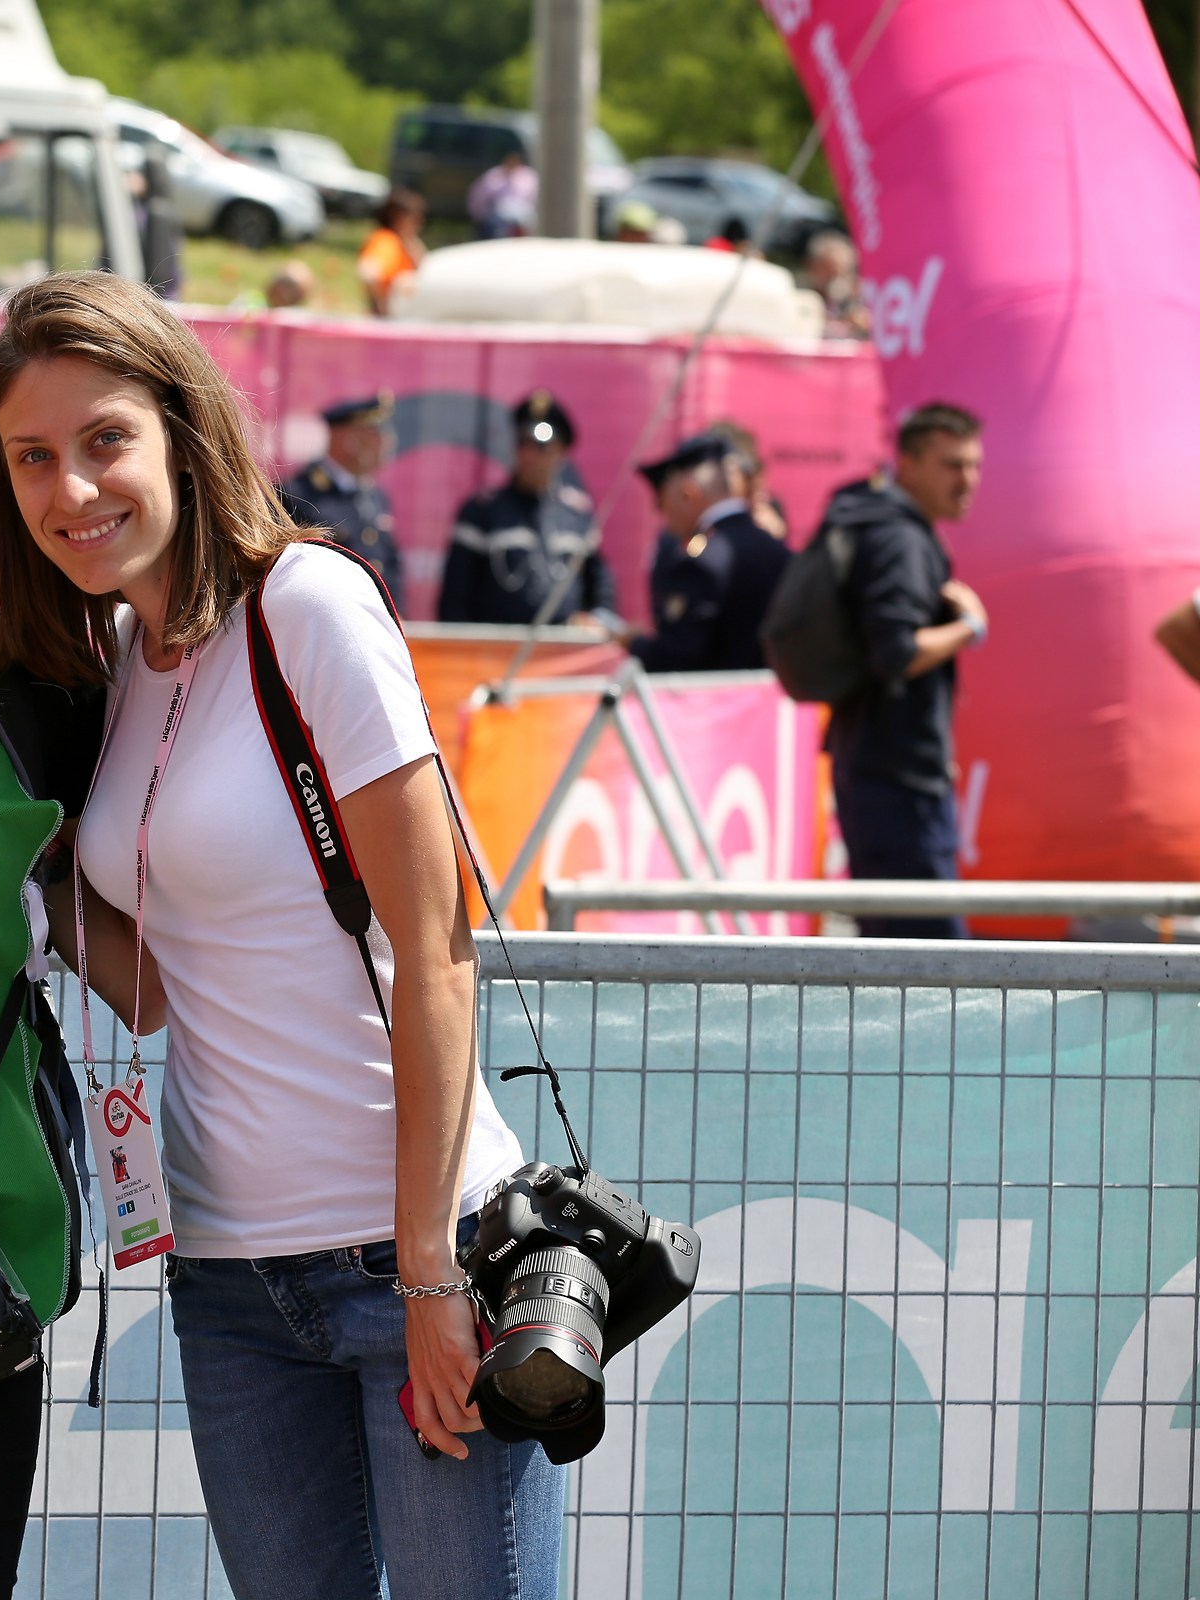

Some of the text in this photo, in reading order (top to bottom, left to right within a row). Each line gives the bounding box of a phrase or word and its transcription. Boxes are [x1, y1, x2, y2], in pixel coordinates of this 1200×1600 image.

[173, 682, 183, 698] Sport
[170, 697, 178, 711] dello
[162, 710, 175, 736] Gazzetta
[161, 734, 168, 742] La
[296, 763, 336, 858] Canon
[561, 1201, 576, 1217] EOS
[569, 1209, 579, 1220] 7D
[488, 1238, 518, 1262] Canon
[617, 1243, 628, 1257] Mark
